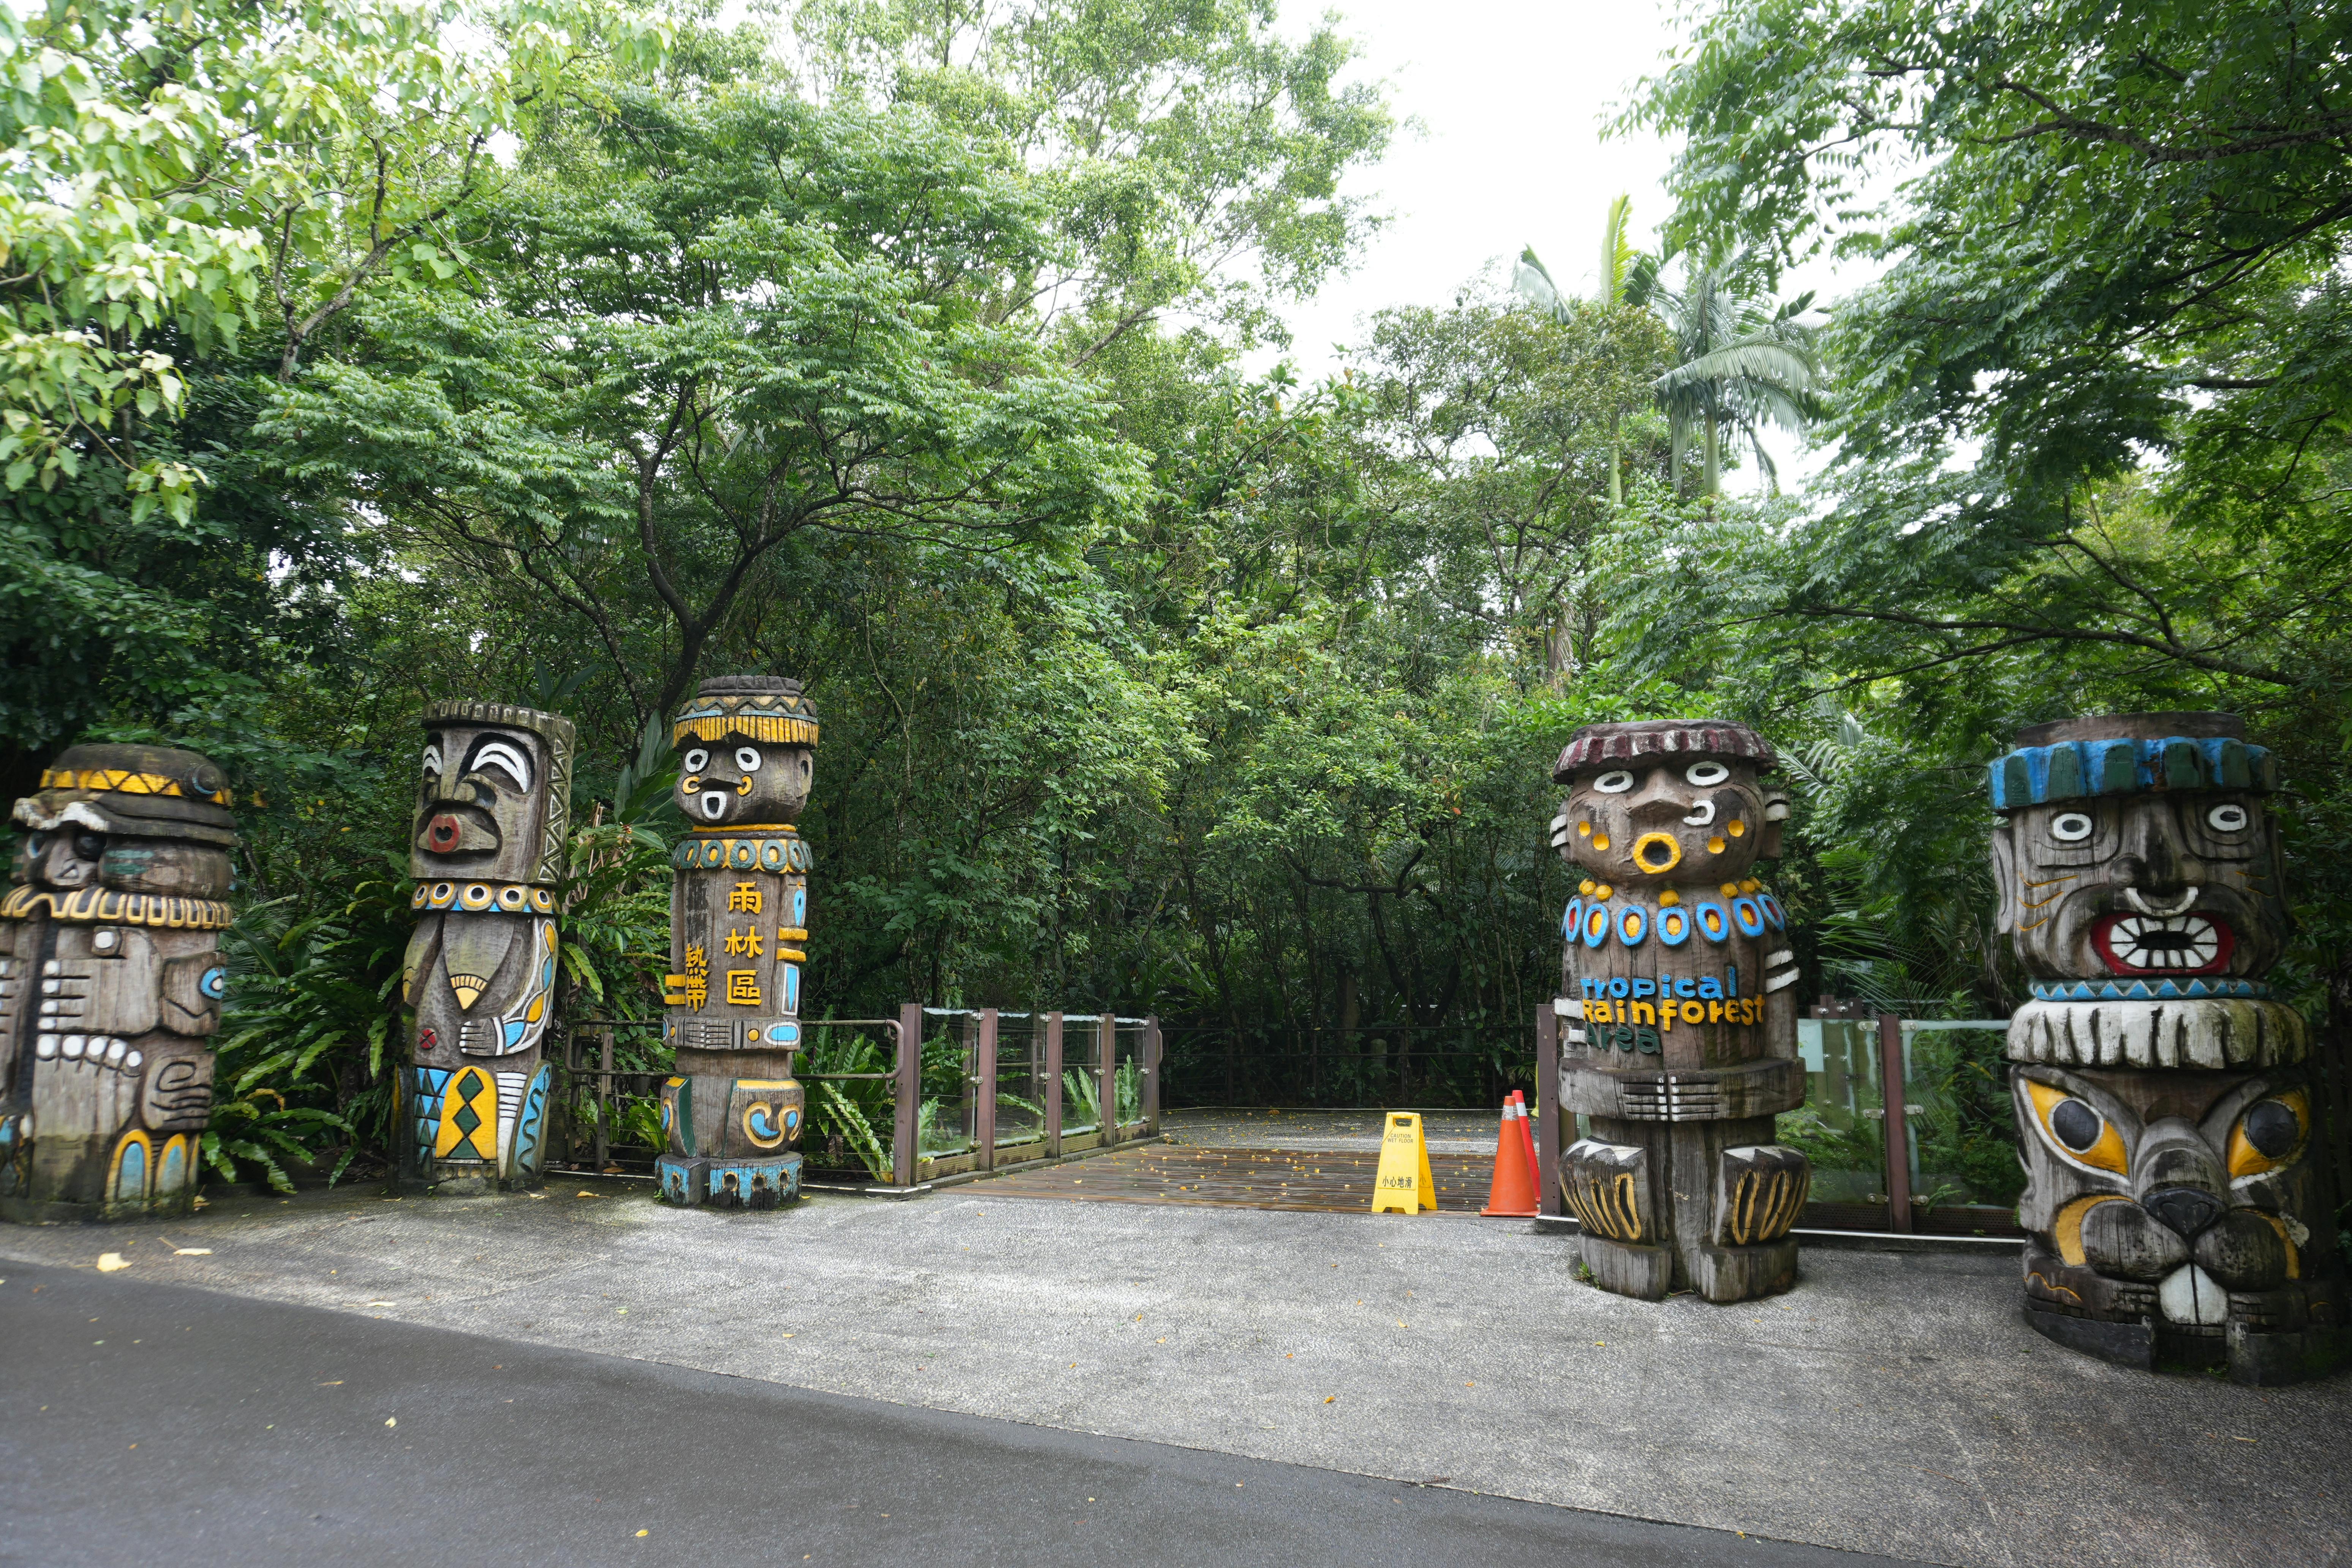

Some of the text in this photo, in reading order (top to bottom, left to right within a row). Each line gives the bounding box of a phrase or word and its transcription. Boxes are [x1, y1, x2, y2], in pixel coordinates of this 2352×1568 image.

[724, 881, 763, 1005] 雨林區
[686, 943, 710, 1012] 熱帶
[1580, 965, 1737, 1000] Tropical
[1582, 994, 1766, 1031] Rainforest
[1587, 1023, 1661, 1054] Area
[1382, 1175, 1412, 1189] 小心地滑
